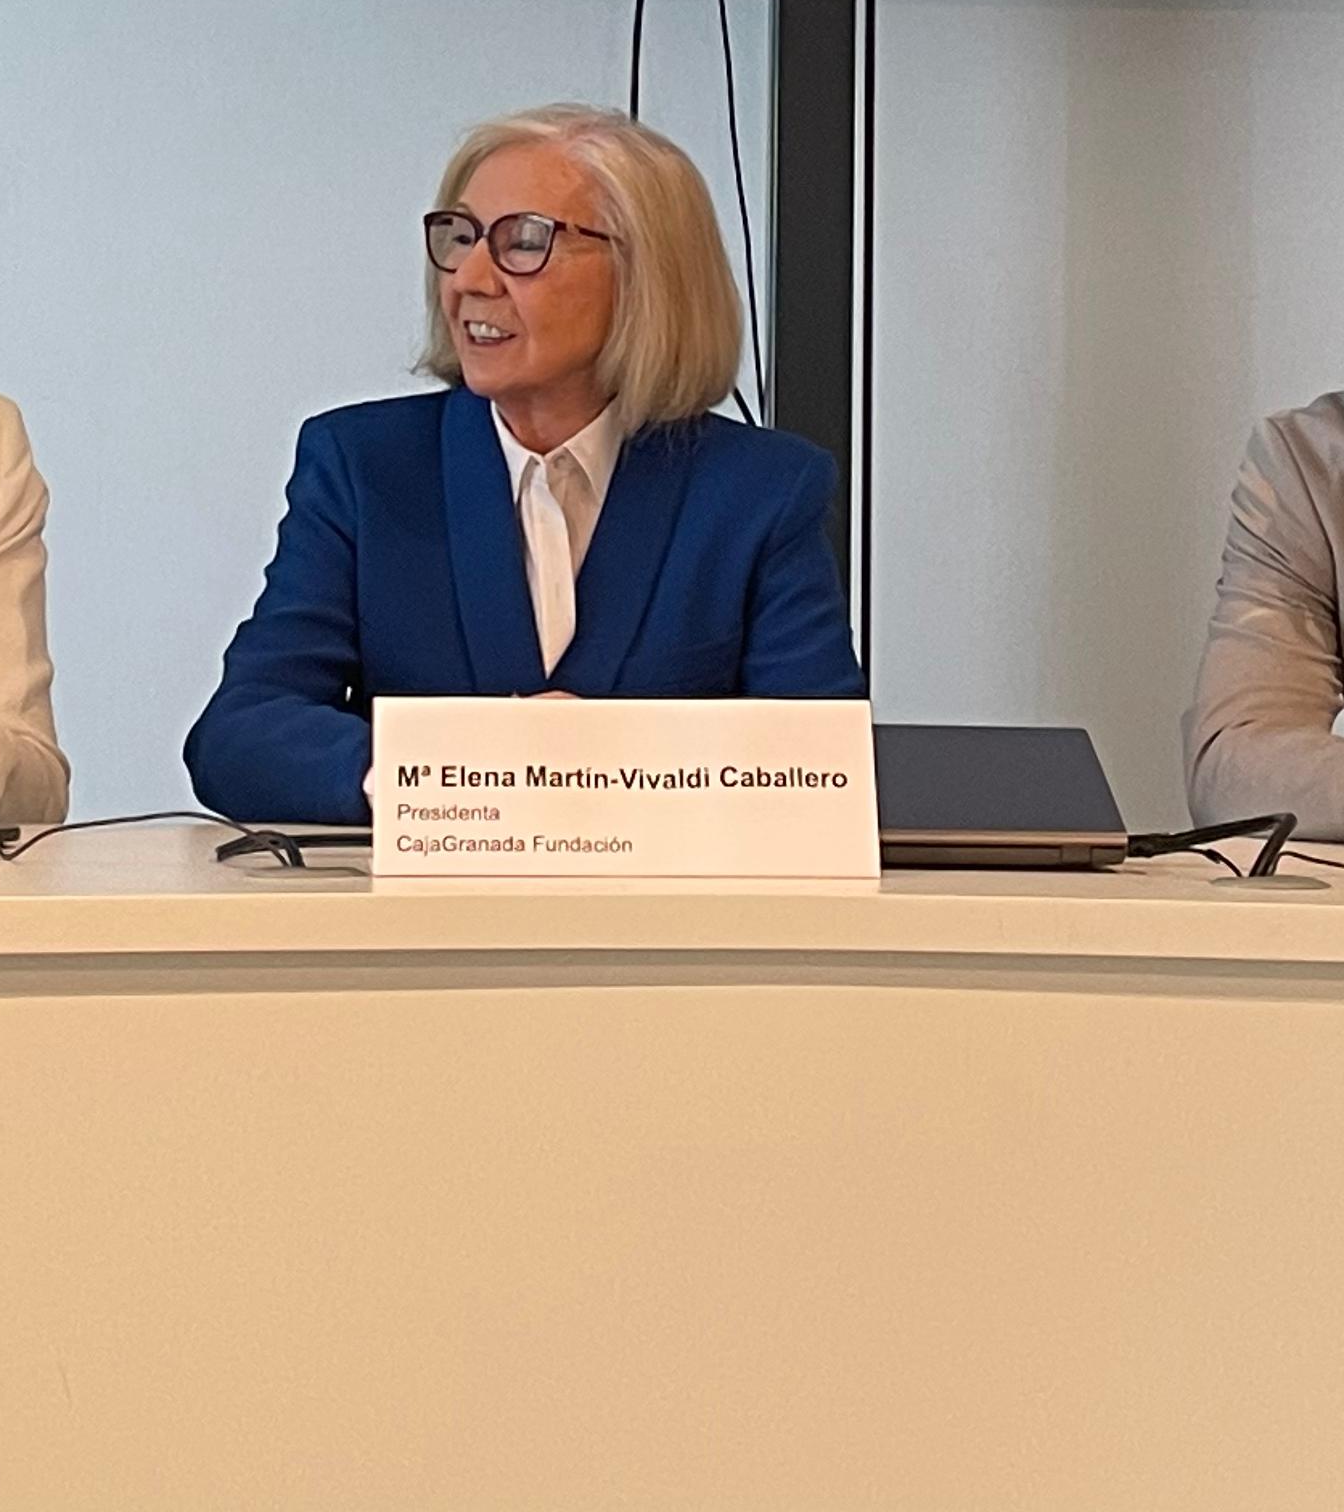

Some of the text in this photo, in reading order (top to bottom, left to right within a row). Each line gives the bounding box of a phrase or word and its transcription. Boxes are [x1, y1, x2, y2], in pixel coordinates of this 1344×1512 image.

[398, 765, 848, 790] Mª Elena Martín-Vivaldi Caballero
[397, 803, 500, 821] Presidenta
[396, 835, 633, 857] CajaGranada Fundación
